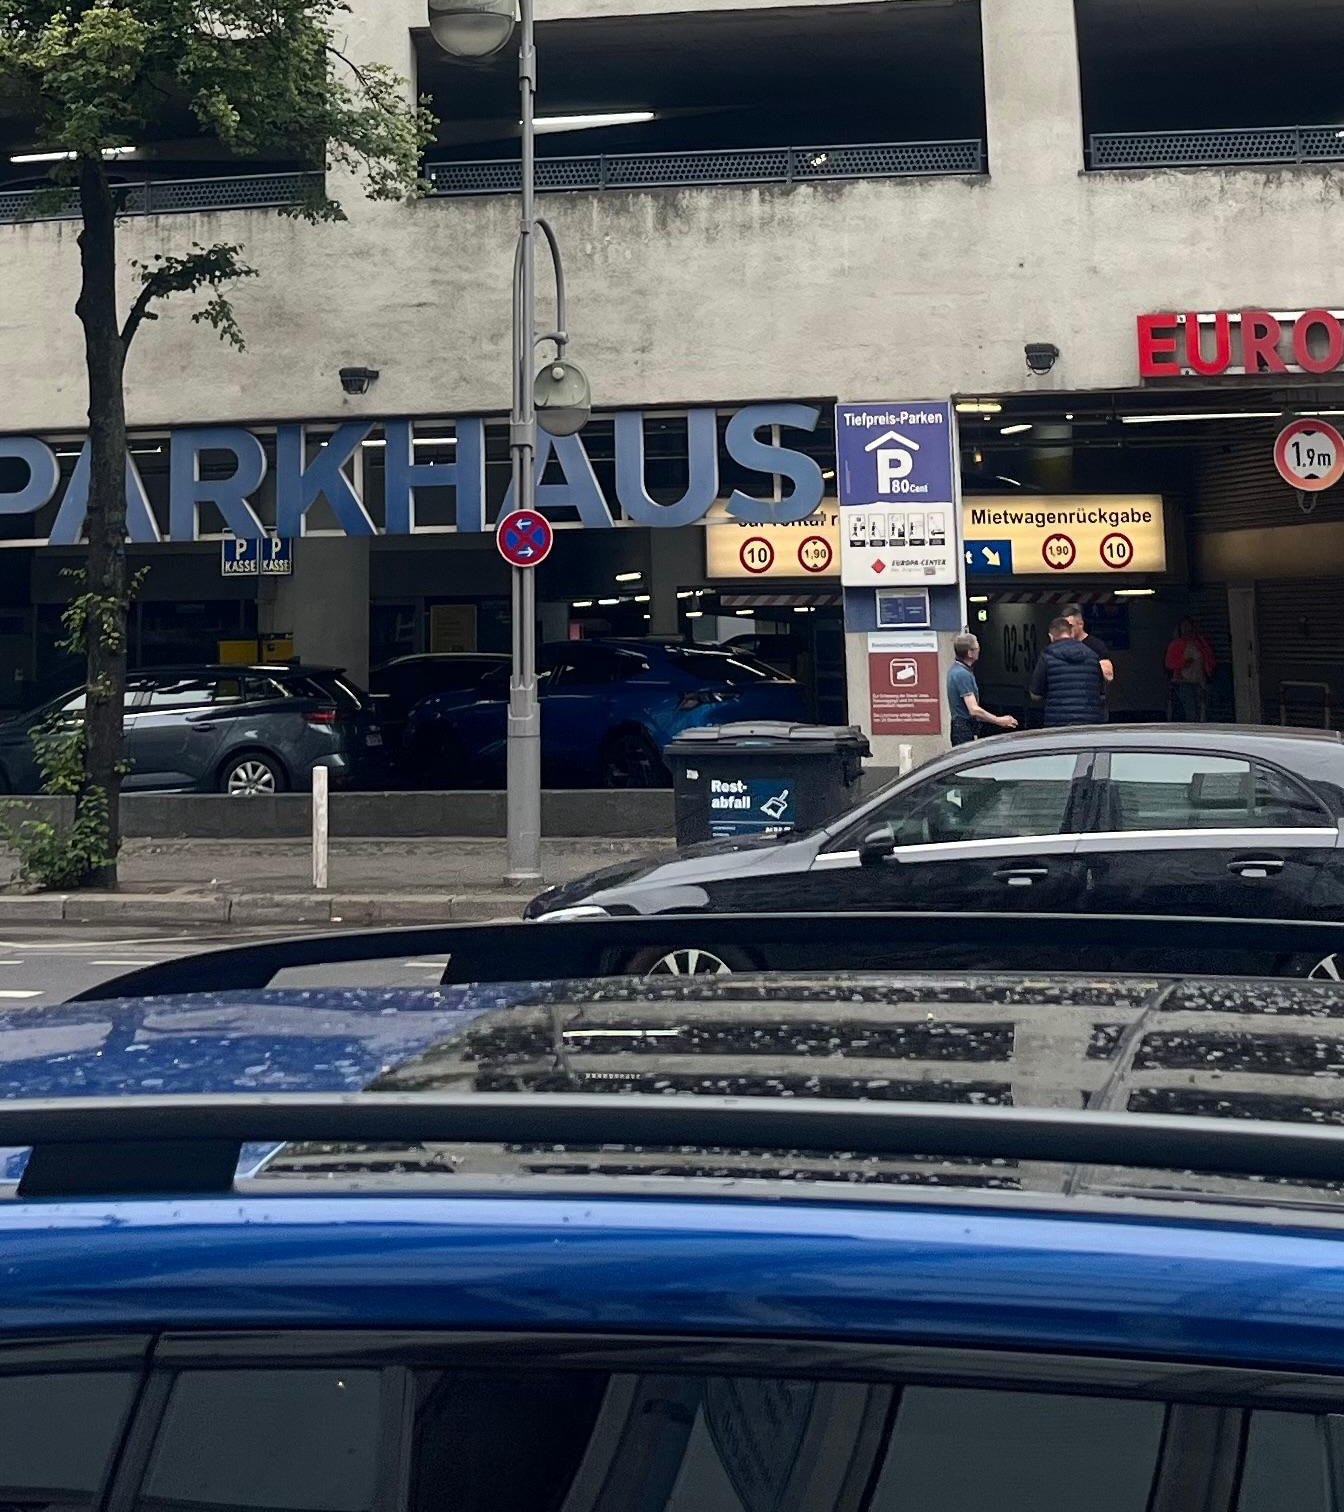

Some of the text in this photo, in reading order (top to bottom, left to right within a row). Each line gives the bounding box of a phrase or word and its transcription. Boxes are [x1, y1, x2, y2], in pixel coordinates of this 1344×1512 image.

[844, 411, 943, 429] Tiefpreis-Parken
[876, 449, 913, 494] P
[892, 479, 910, 493] 80
[971, 508, 1152, 528] Mietwagenrückgabe
[236, 538, 247, 560] P
[271, 537, 282, 560] P
[747, 547, 768, 563] 10
[805, 548, 827, 560] 1,90
[1106, 543, 1126, 558] 10
[225, 560, 256, 573] KASSE
[262, 559, 289, 572] KASSE
[711, 796, 751, 809] abfall
